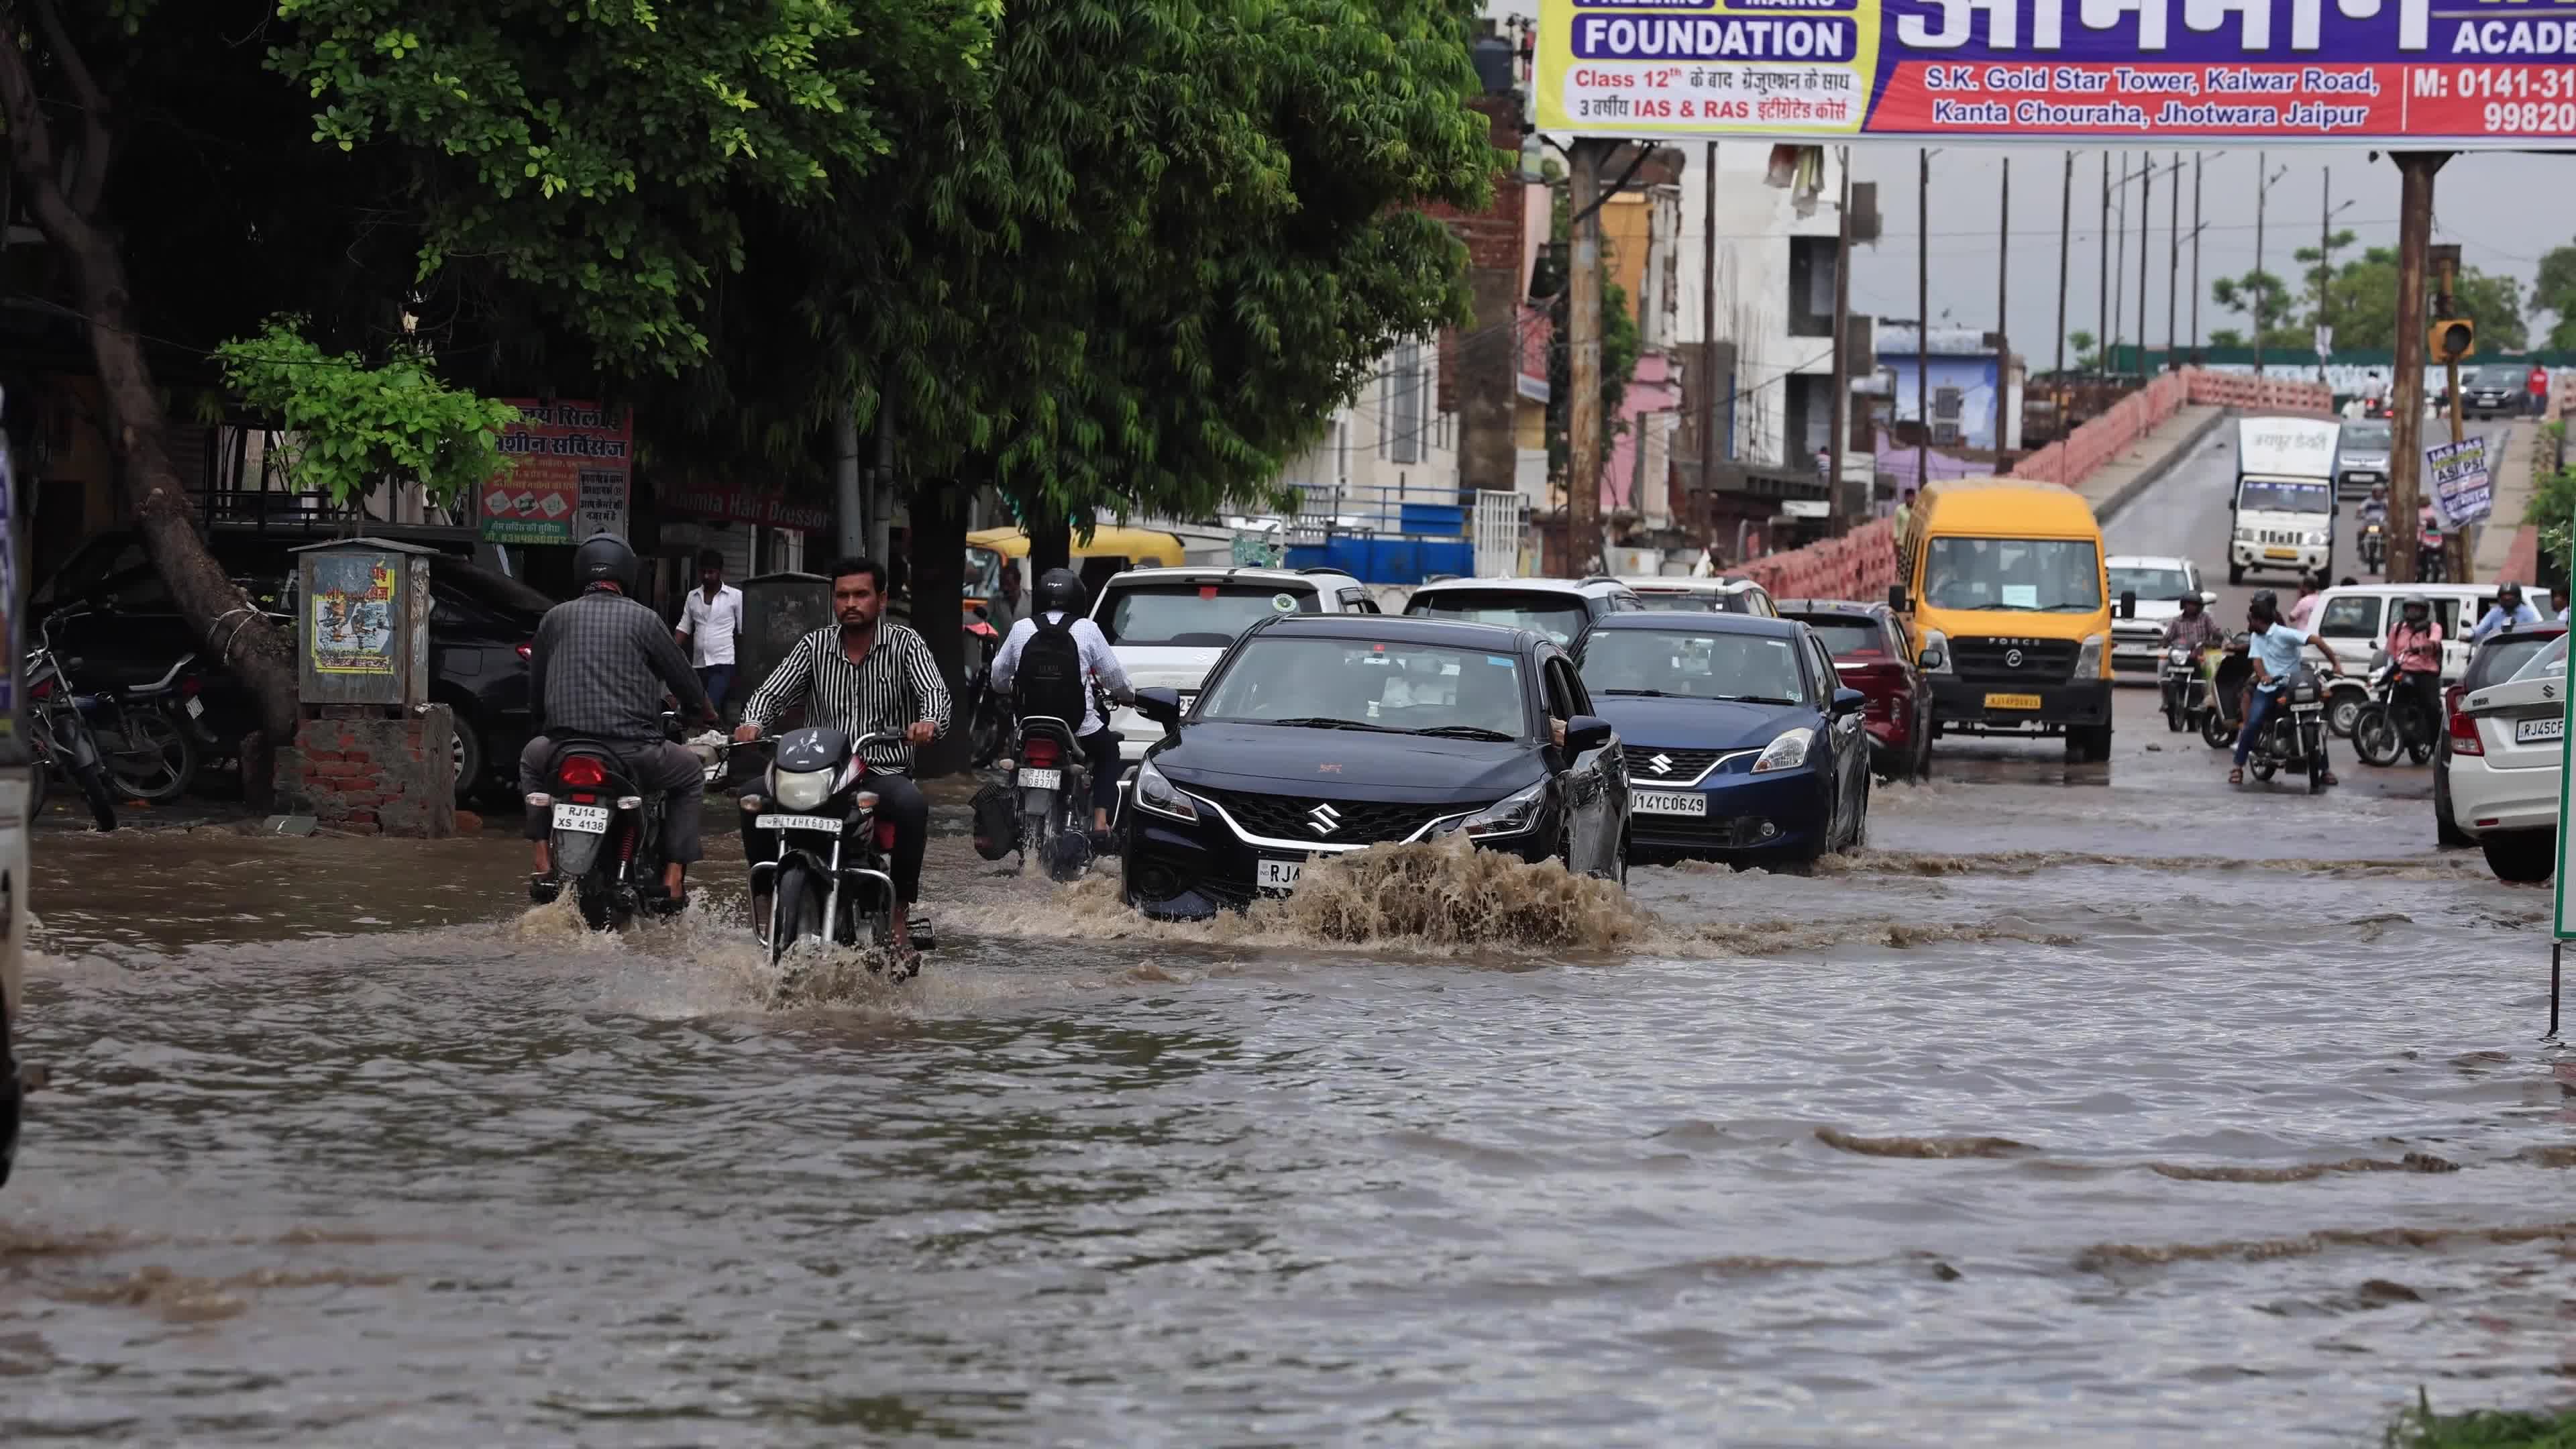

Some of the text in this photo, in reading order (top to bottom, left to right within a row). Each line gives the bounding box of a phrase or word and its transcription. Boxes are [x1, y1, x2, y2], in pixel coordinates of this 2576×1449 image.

[1585, 19, 1843, 56] FOUNDATION
[2452, 21, 2576, 54] ACADE
[1575, 70, 1635, 87] Class
[1690, 66, 1704, 88] के
[1708, 71, 1733, 89] बाद
[1805, 68, 1819, 89] के
[1926, 67, 2379, 95] S.K. Gold Star Tower, Kalwar Road,
[2414, 68, 2575, 98] M: 0141-31
[1580, 99, 1589, 116] 3
[1634, 99, 1672, 117] IAS
[1680, 99, 1695, 117] &
[1705, 100, 1750, 119] RAS
[1935, 101, 2367, 129] Kanta Chouraha, Jhotwara Jaipur
[2485, 102, 2576, 132] 99820
[557, 818, 604, 831] XS 4138
[568, 806, 596, 817] RJ14
